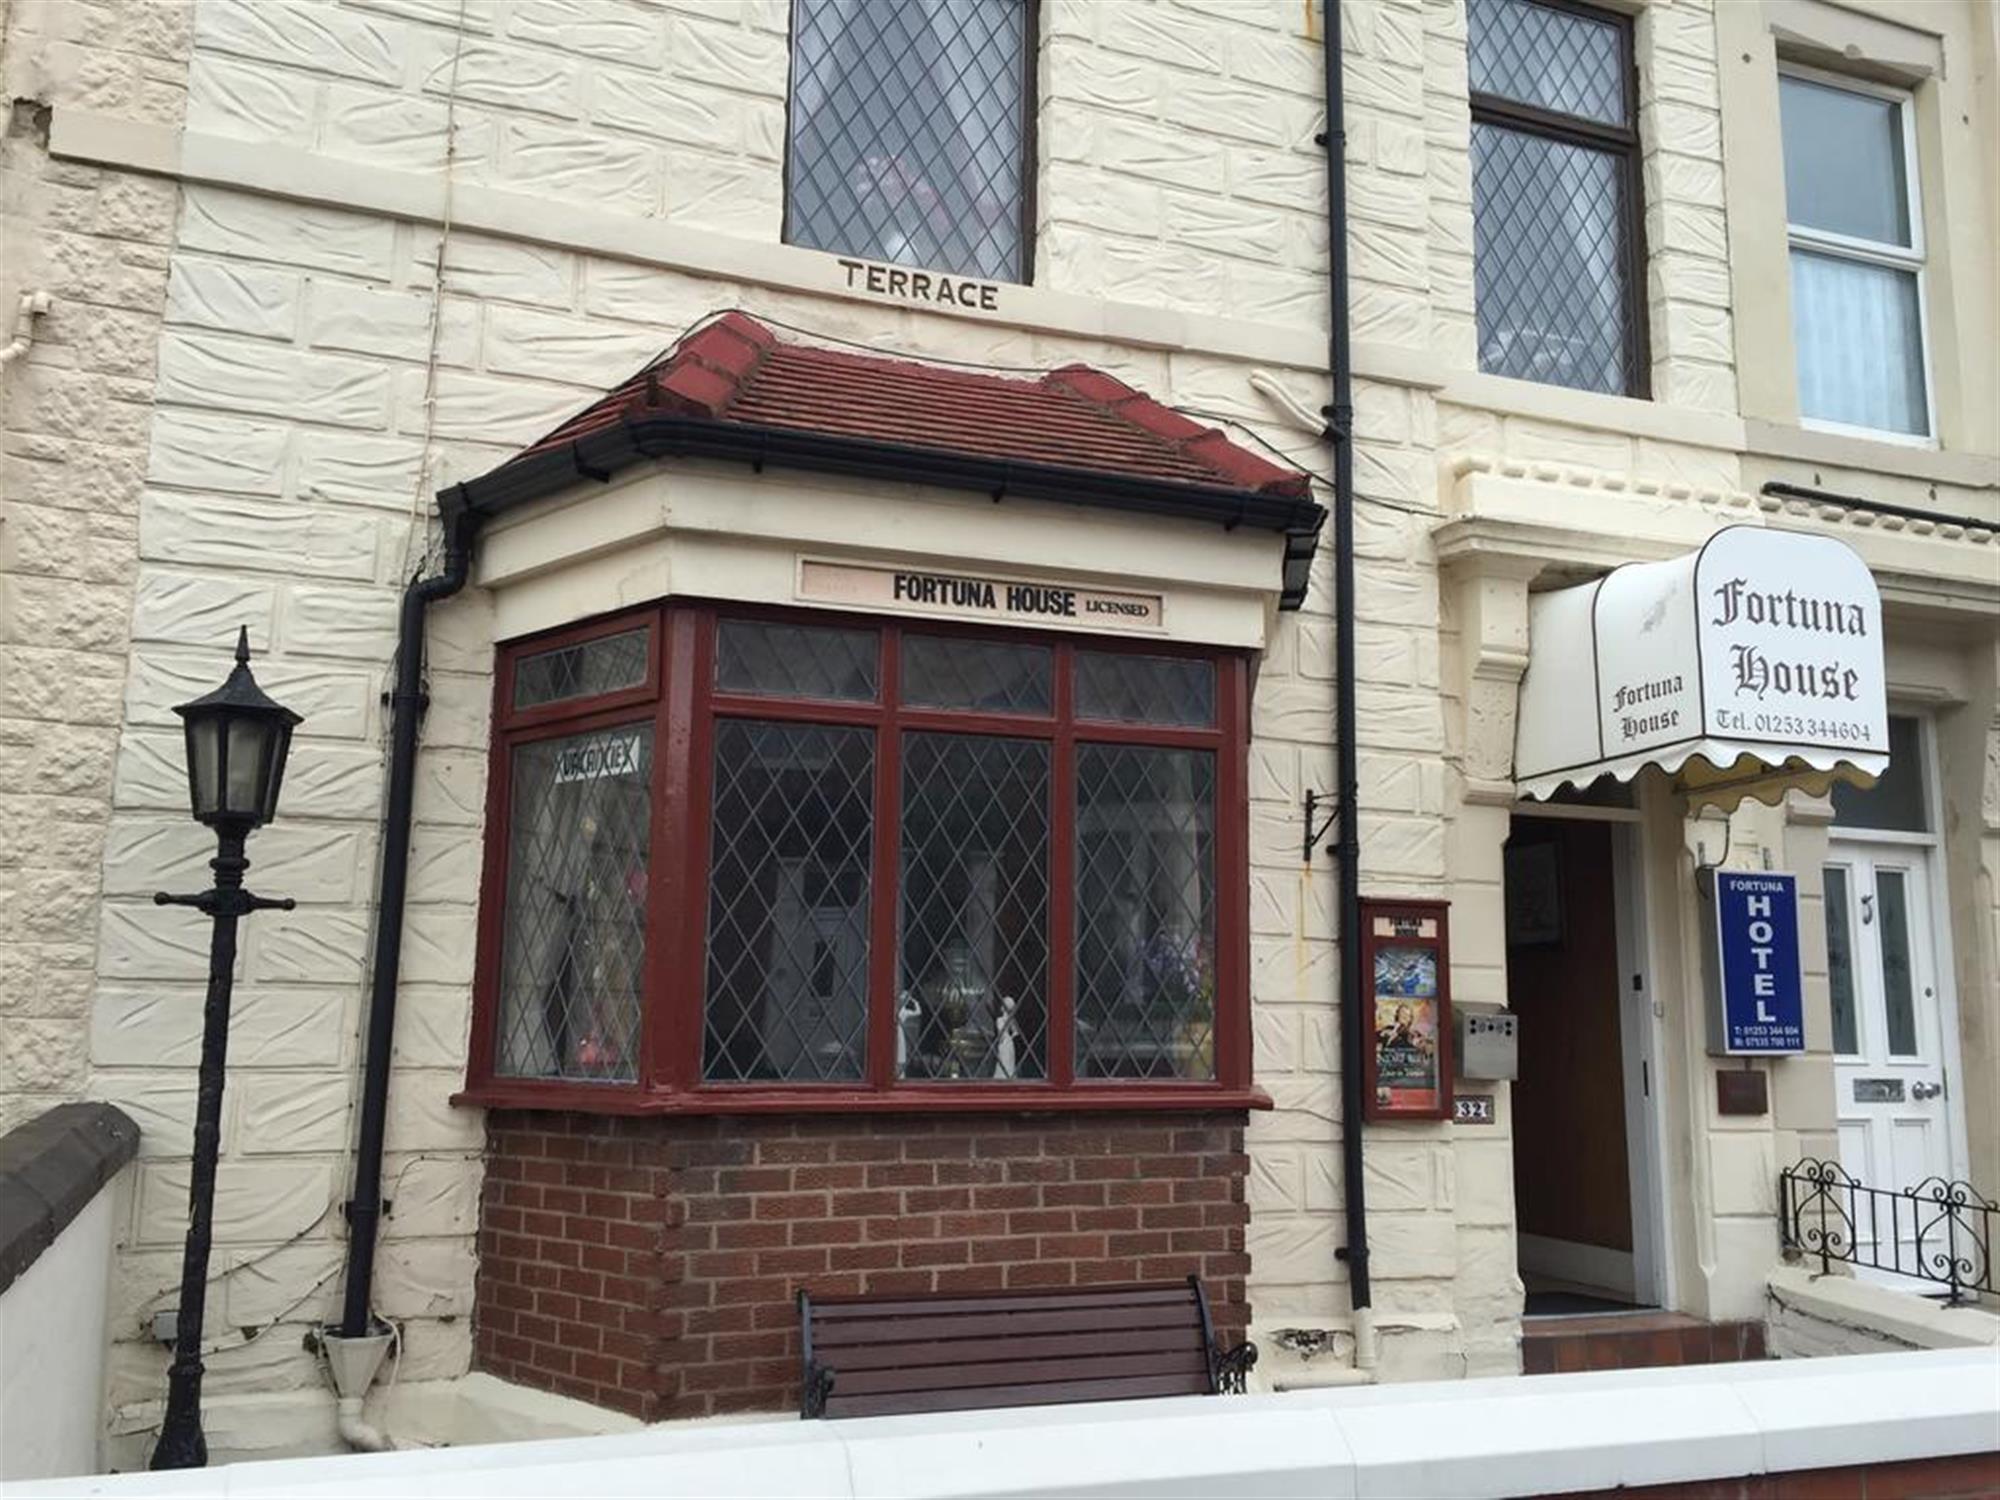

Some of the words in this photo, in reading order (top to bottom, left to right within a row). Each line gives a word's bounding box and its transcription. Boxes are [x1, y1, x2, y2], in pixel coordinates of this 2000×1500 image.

[837, 259, 999, 311] TERRACE
[893, 574, 997, 610] FORTUNA
[1006, 584, 1077, 618] HOUSE
[1085, 599, 1150, 618] LICENSED
[1711, 577, 1867, 637] Fortuna
[1612, 674, 1684, 713] Fortuna
[1729, 644, 1860, 701] House
[1621, 709, 1680, 743] House
[1716, 708, 1752, 731] Tel.
[1729, 879, 1785, 893] FORTUNA
[1746, 894, 1777, 1023] HOTEL
